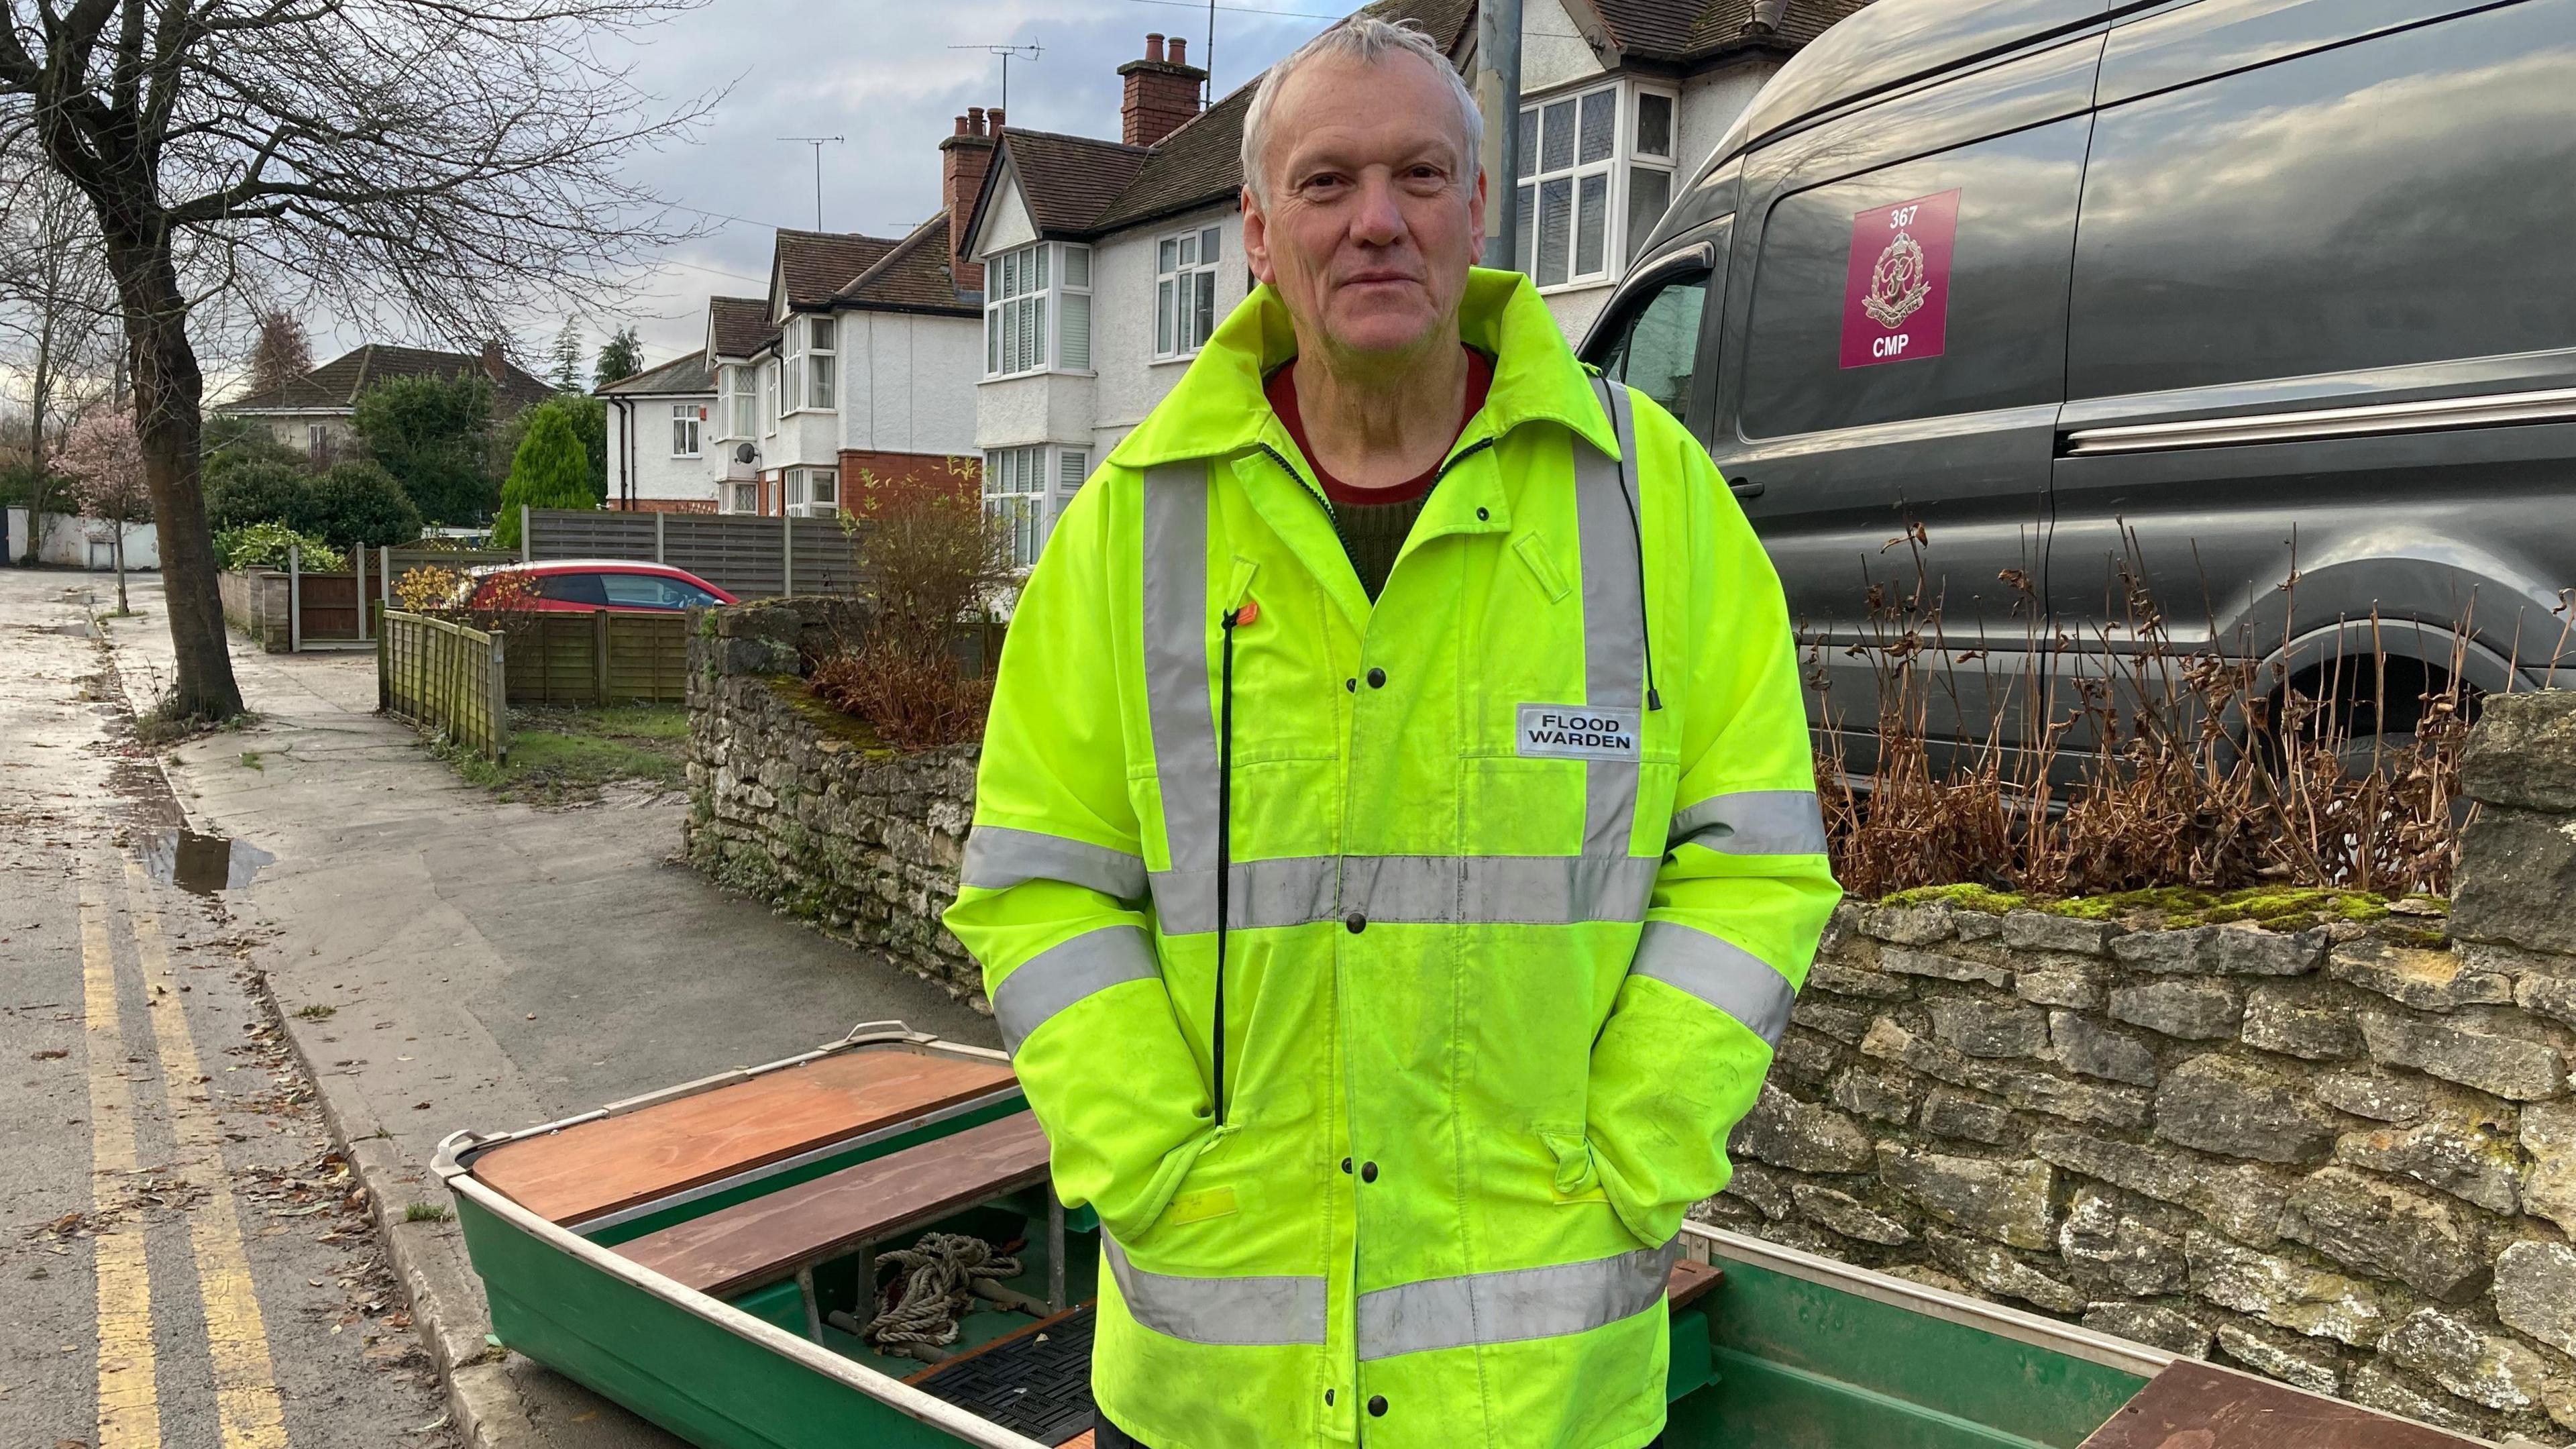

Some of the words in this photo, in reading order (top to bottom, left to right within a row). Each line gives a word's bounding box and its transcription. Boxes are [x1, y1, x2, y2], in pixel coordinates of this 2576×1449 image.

[1890, 205, 1918, 229] 367
[1873, 334, 1909, 357] CMP
[1542, 715, 1619, 732] FLOOD
[1528, 730, 1630, 749] WARDEN
